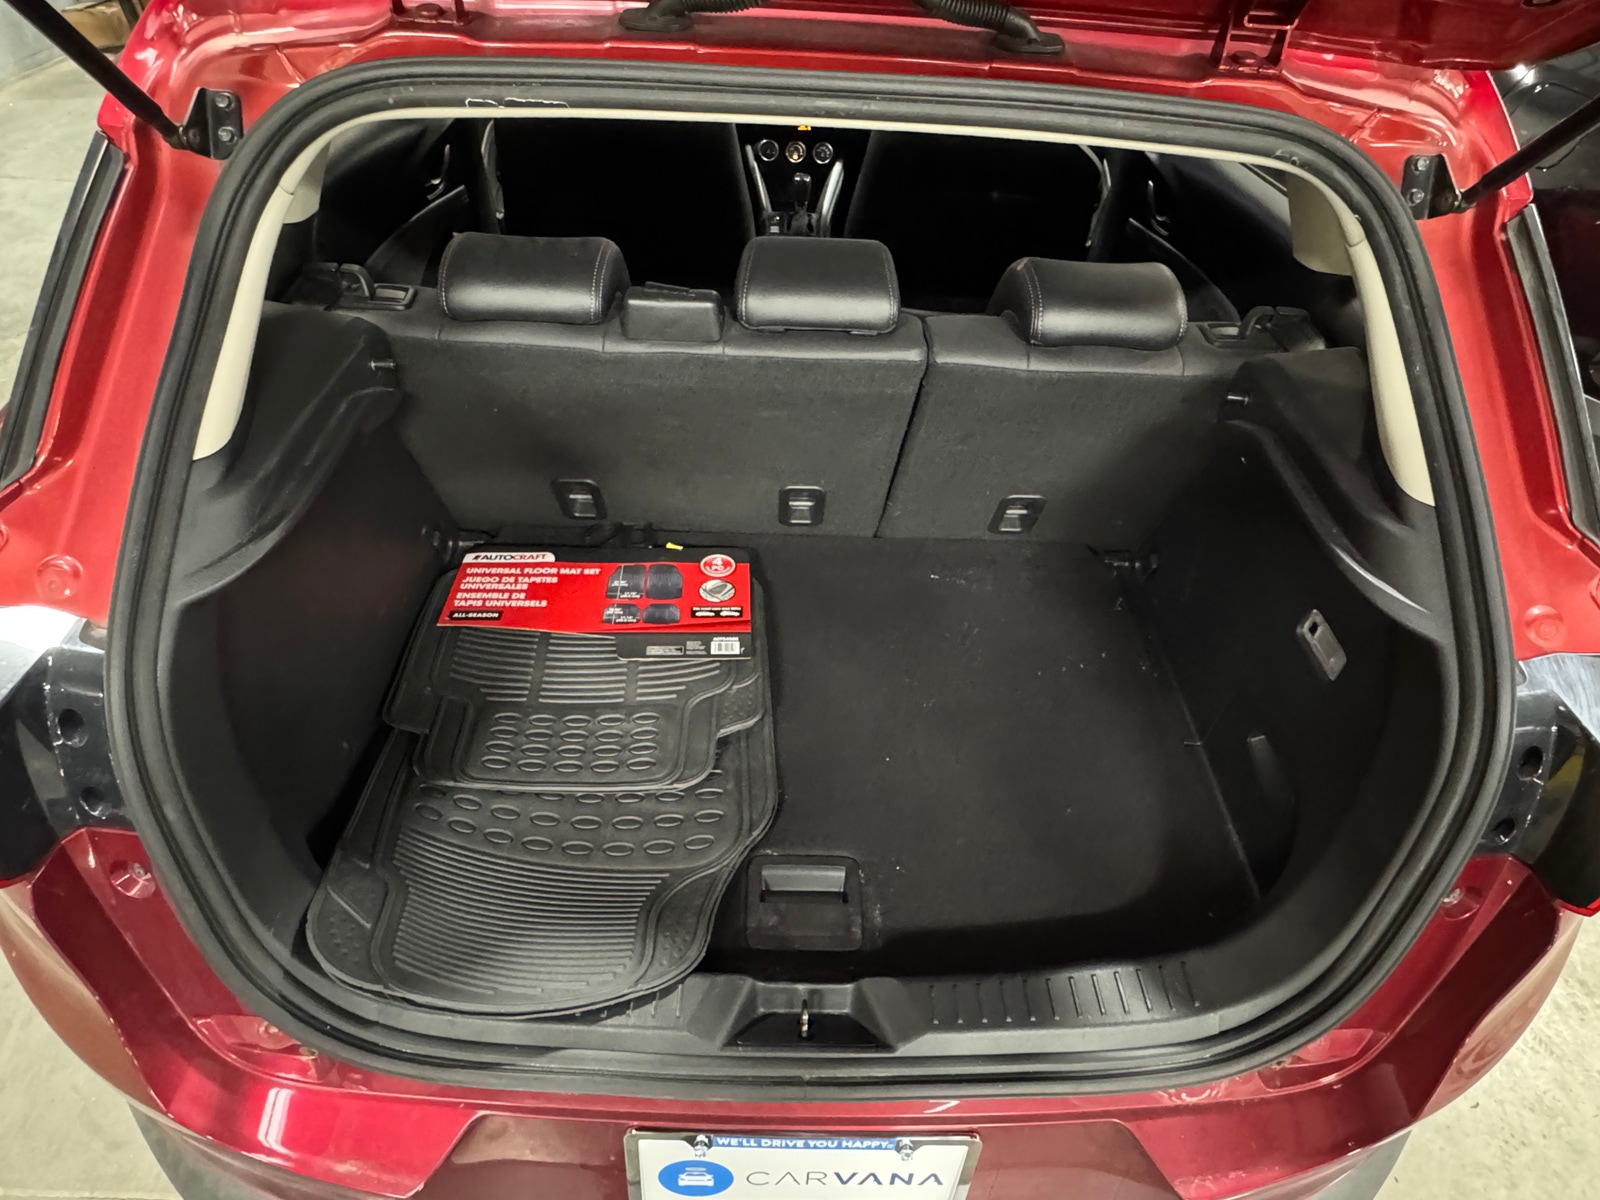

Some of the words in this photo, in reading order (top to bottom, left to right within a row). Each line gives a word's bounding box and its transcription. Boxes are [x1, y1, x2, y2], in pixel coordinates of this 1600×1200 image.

[480, 553, 547, 561] AUTOCRAFT
[712, 557, 724, 566] 4
[466, 567, 521, 575] UNIVERSAL
[523, 567, 558, 575] FLOOR
[517, 576, 559, 584] TAPETES
[511, 592, 526, 600] DE
[453, 599, 483, 607] TAPIS
[716, 1137, 758, 1147] WE'LL
[760, 1138, 803, 1148] DRIVE
[807, 1139, 839, 1148] YOU
[746, 1171, 944, 1186] CARVANA
